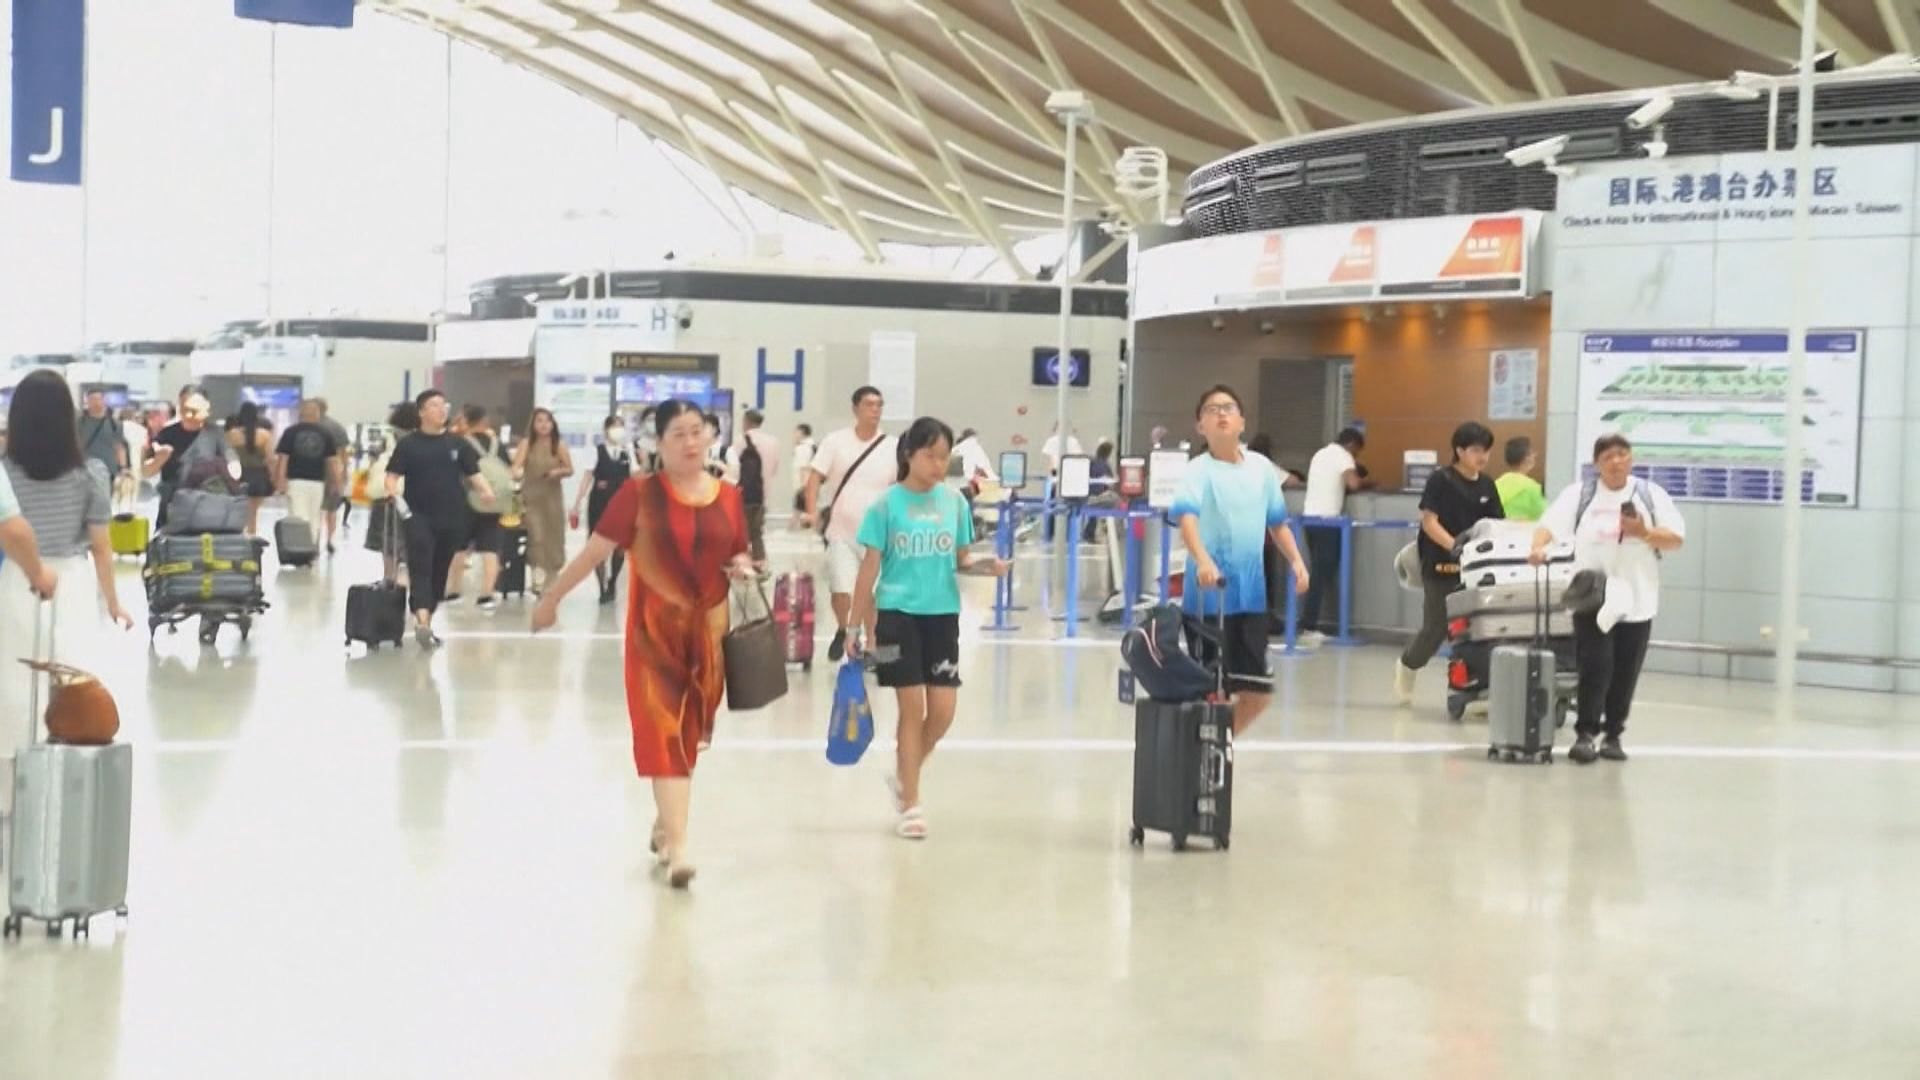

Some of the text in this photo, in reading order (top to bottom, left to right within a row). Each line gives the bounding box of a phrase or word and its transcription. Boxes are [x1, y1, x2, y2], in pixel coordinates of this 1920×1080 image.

[28, 107, 63, 164] J
[651, 306, 667, 331] H
[756, 347, 805, 412] H
